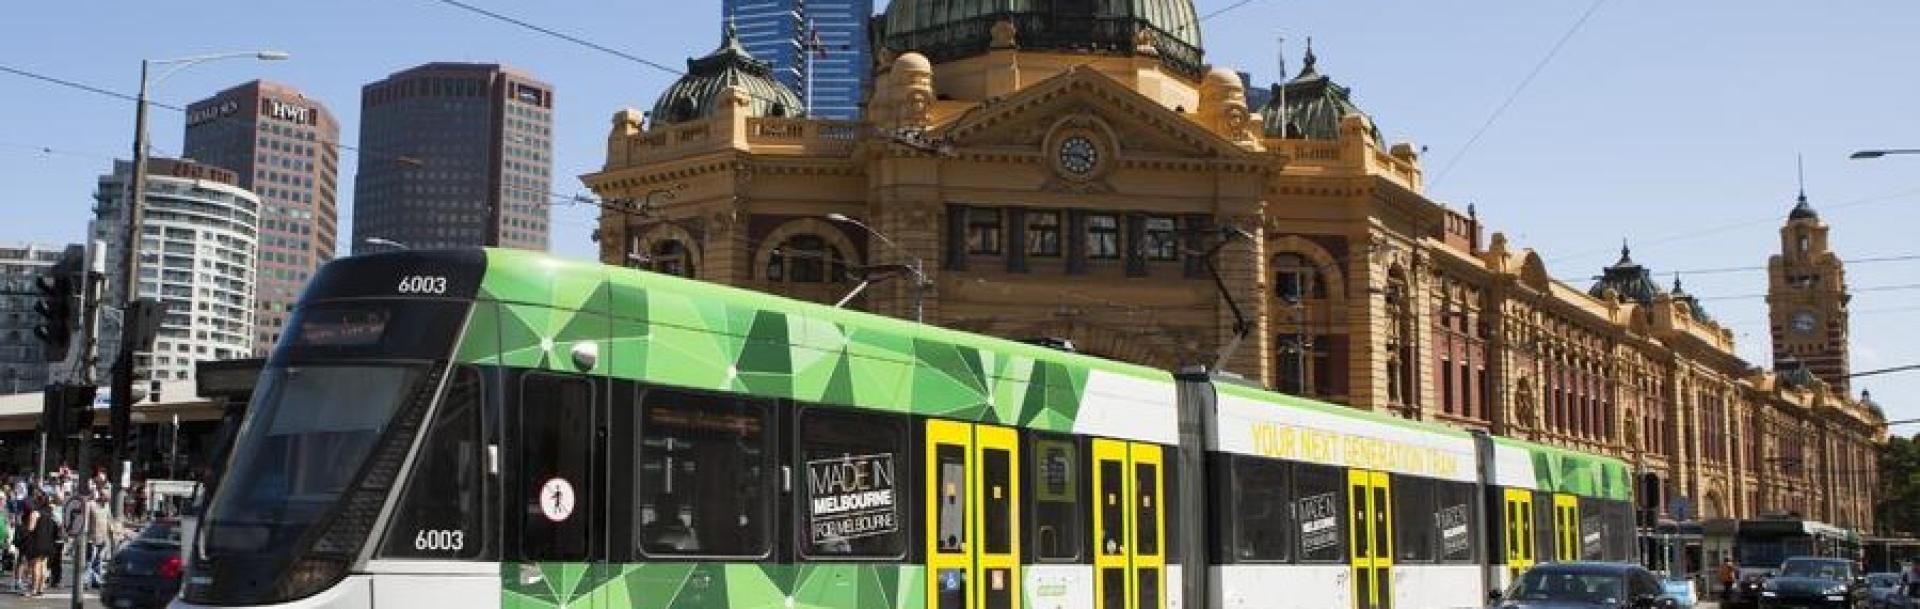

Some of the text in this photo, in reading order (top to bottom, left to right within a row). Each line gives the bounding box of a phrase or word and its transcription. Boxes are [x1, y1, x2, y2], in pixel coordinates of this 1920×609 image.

[273, 101, 307, 121] HWT
[398, 275, 446, 294] 6003
[1252, 421, 1295, 457] YOUR
[1300, 427, 1339, 462] NEXT
[811, 459, 894, 494] MADE IN
[814, 489, 892, 514] MELBOURNE
[815, 514, 895, 538] FOR MELBOURNE
[415, 529, 464, 550] 6003
